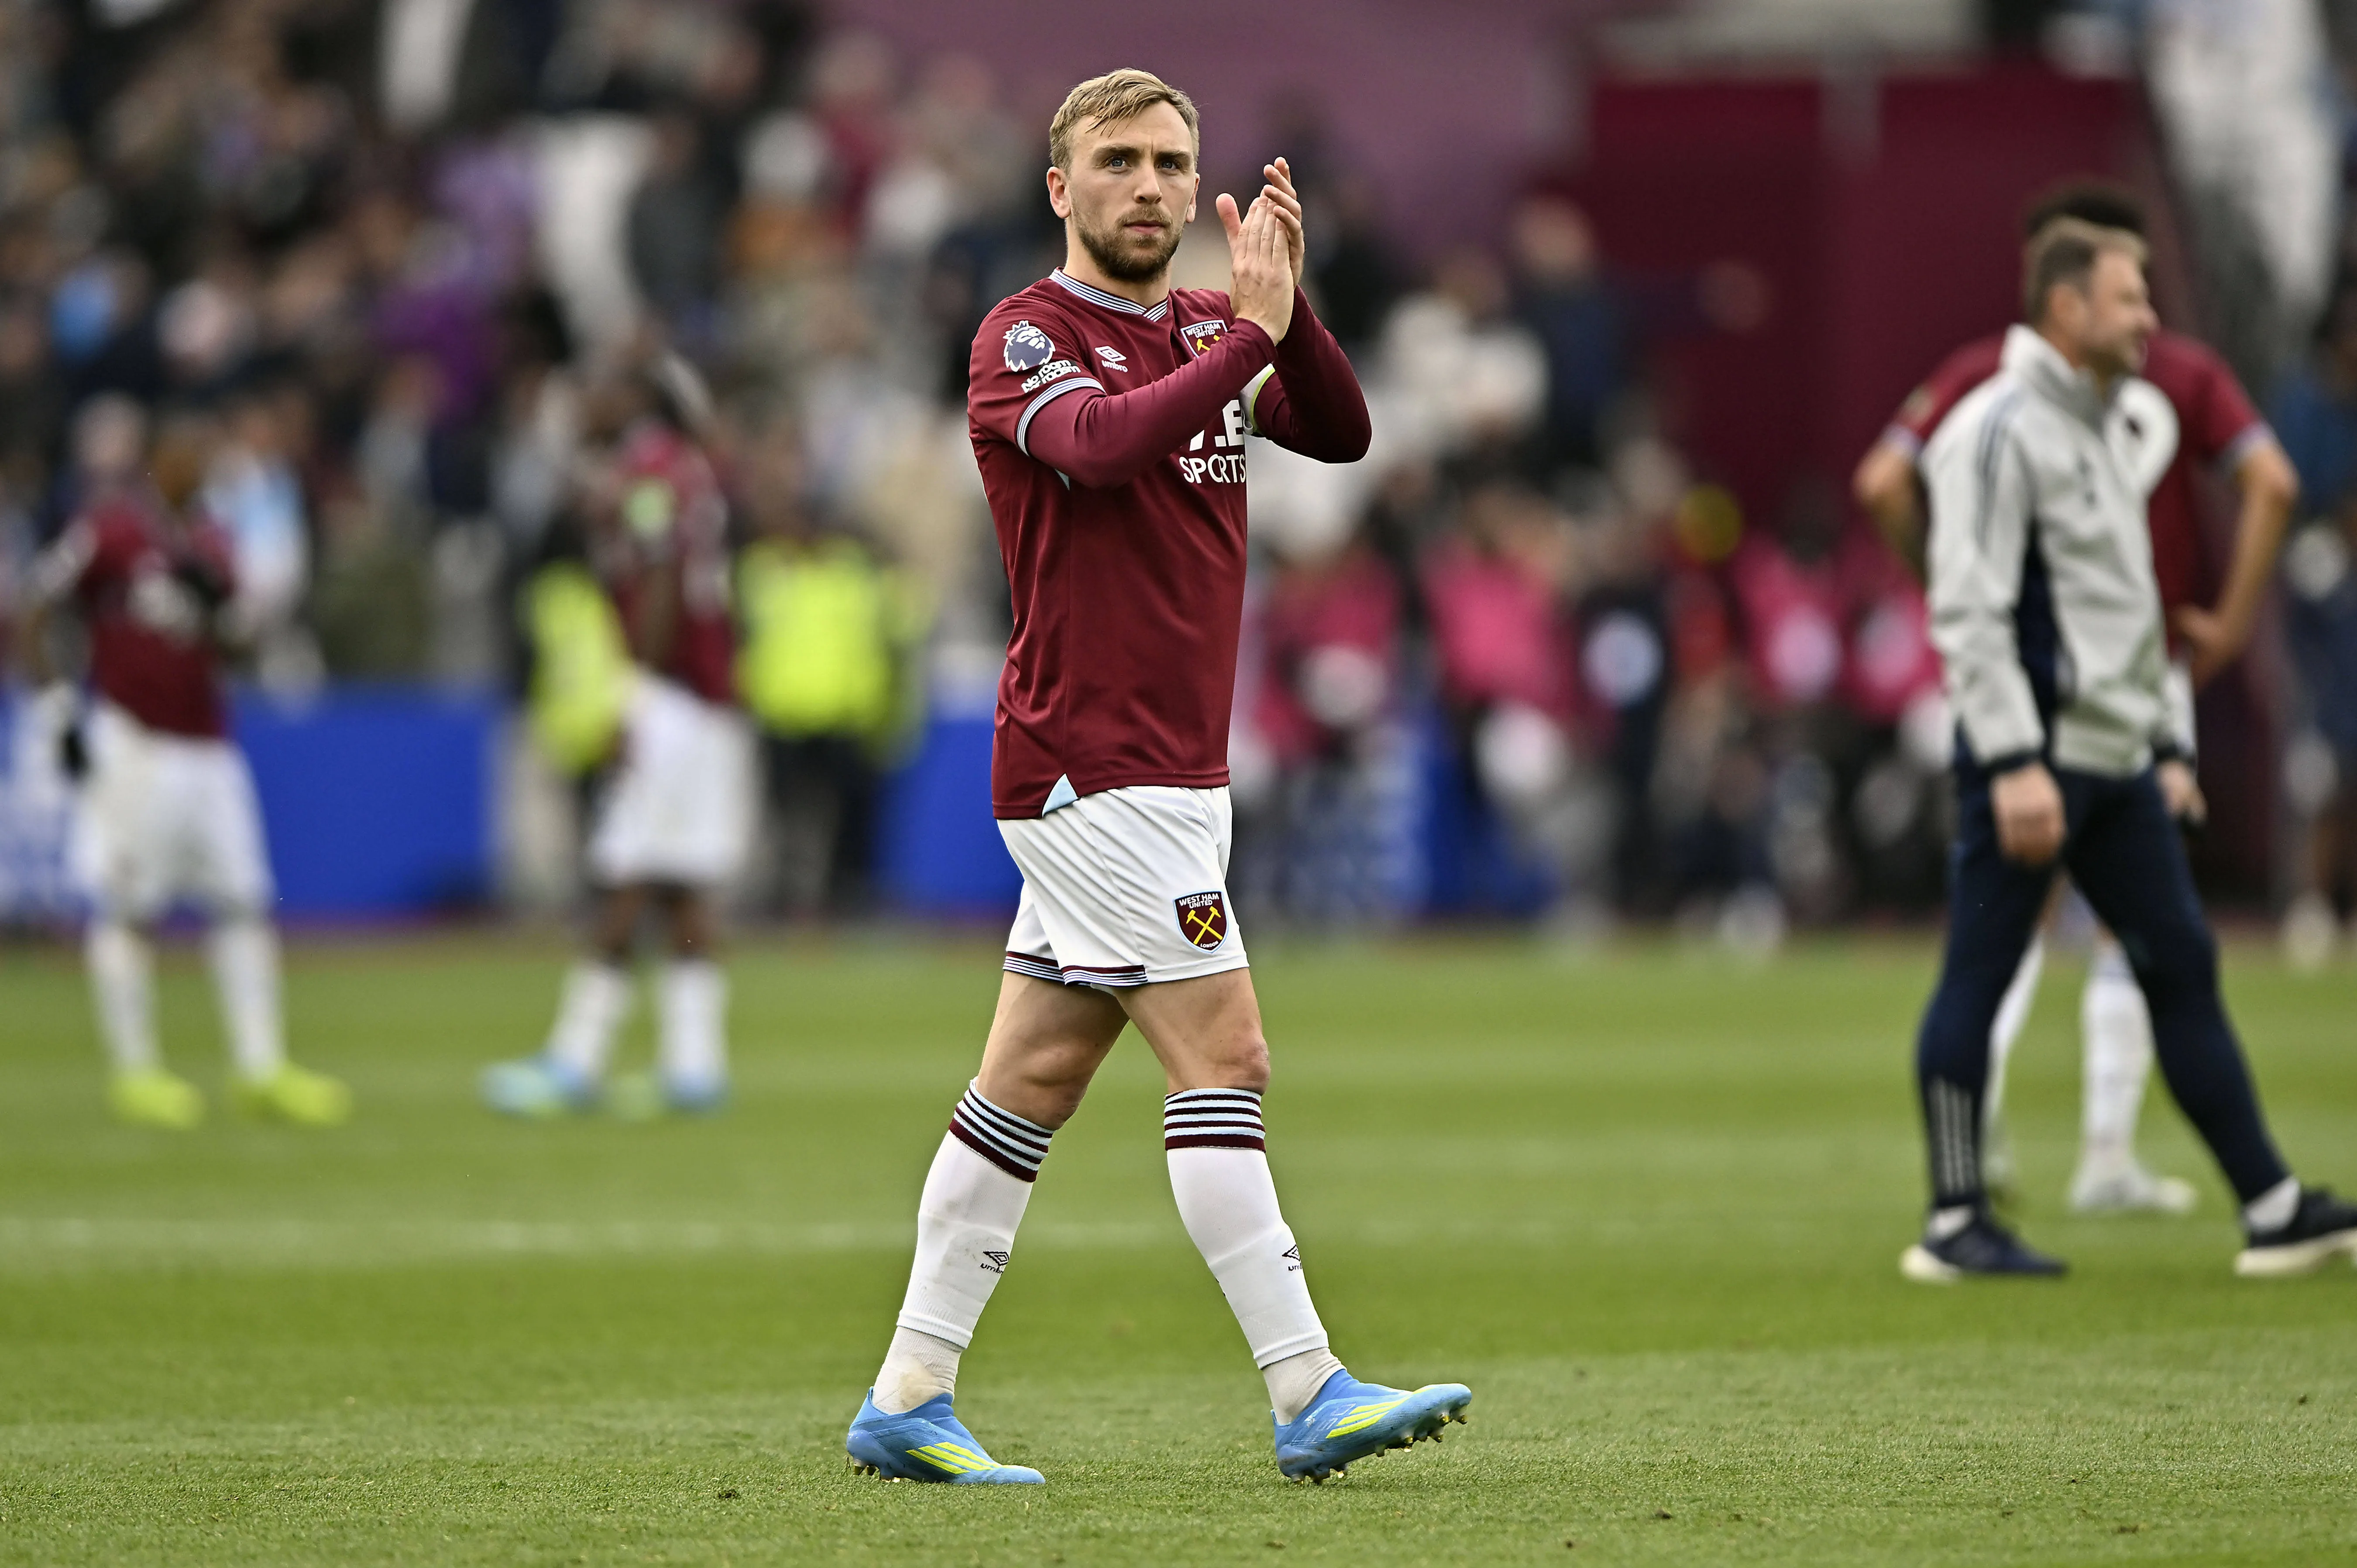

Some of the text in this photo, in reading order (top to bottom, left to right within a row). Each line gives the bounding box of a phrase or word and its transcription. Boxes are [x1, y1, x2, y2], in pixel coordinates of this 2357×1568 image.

[1186, 325, 1203, 336] WEST
[1195, 329, 1216, 338] UNITED
[1102, 360, 1128, 372] umbro
[1021, 375, 1039, 393] No
[1038, 360, 1072, 378] room
[1179, 454, 1246, 484] SPORTS
[1179, 893, 1220, 906] WEST HAM
[1189, 900, 1213, 909] UNITED
[980, 1263, 1004, 1275] umbr
